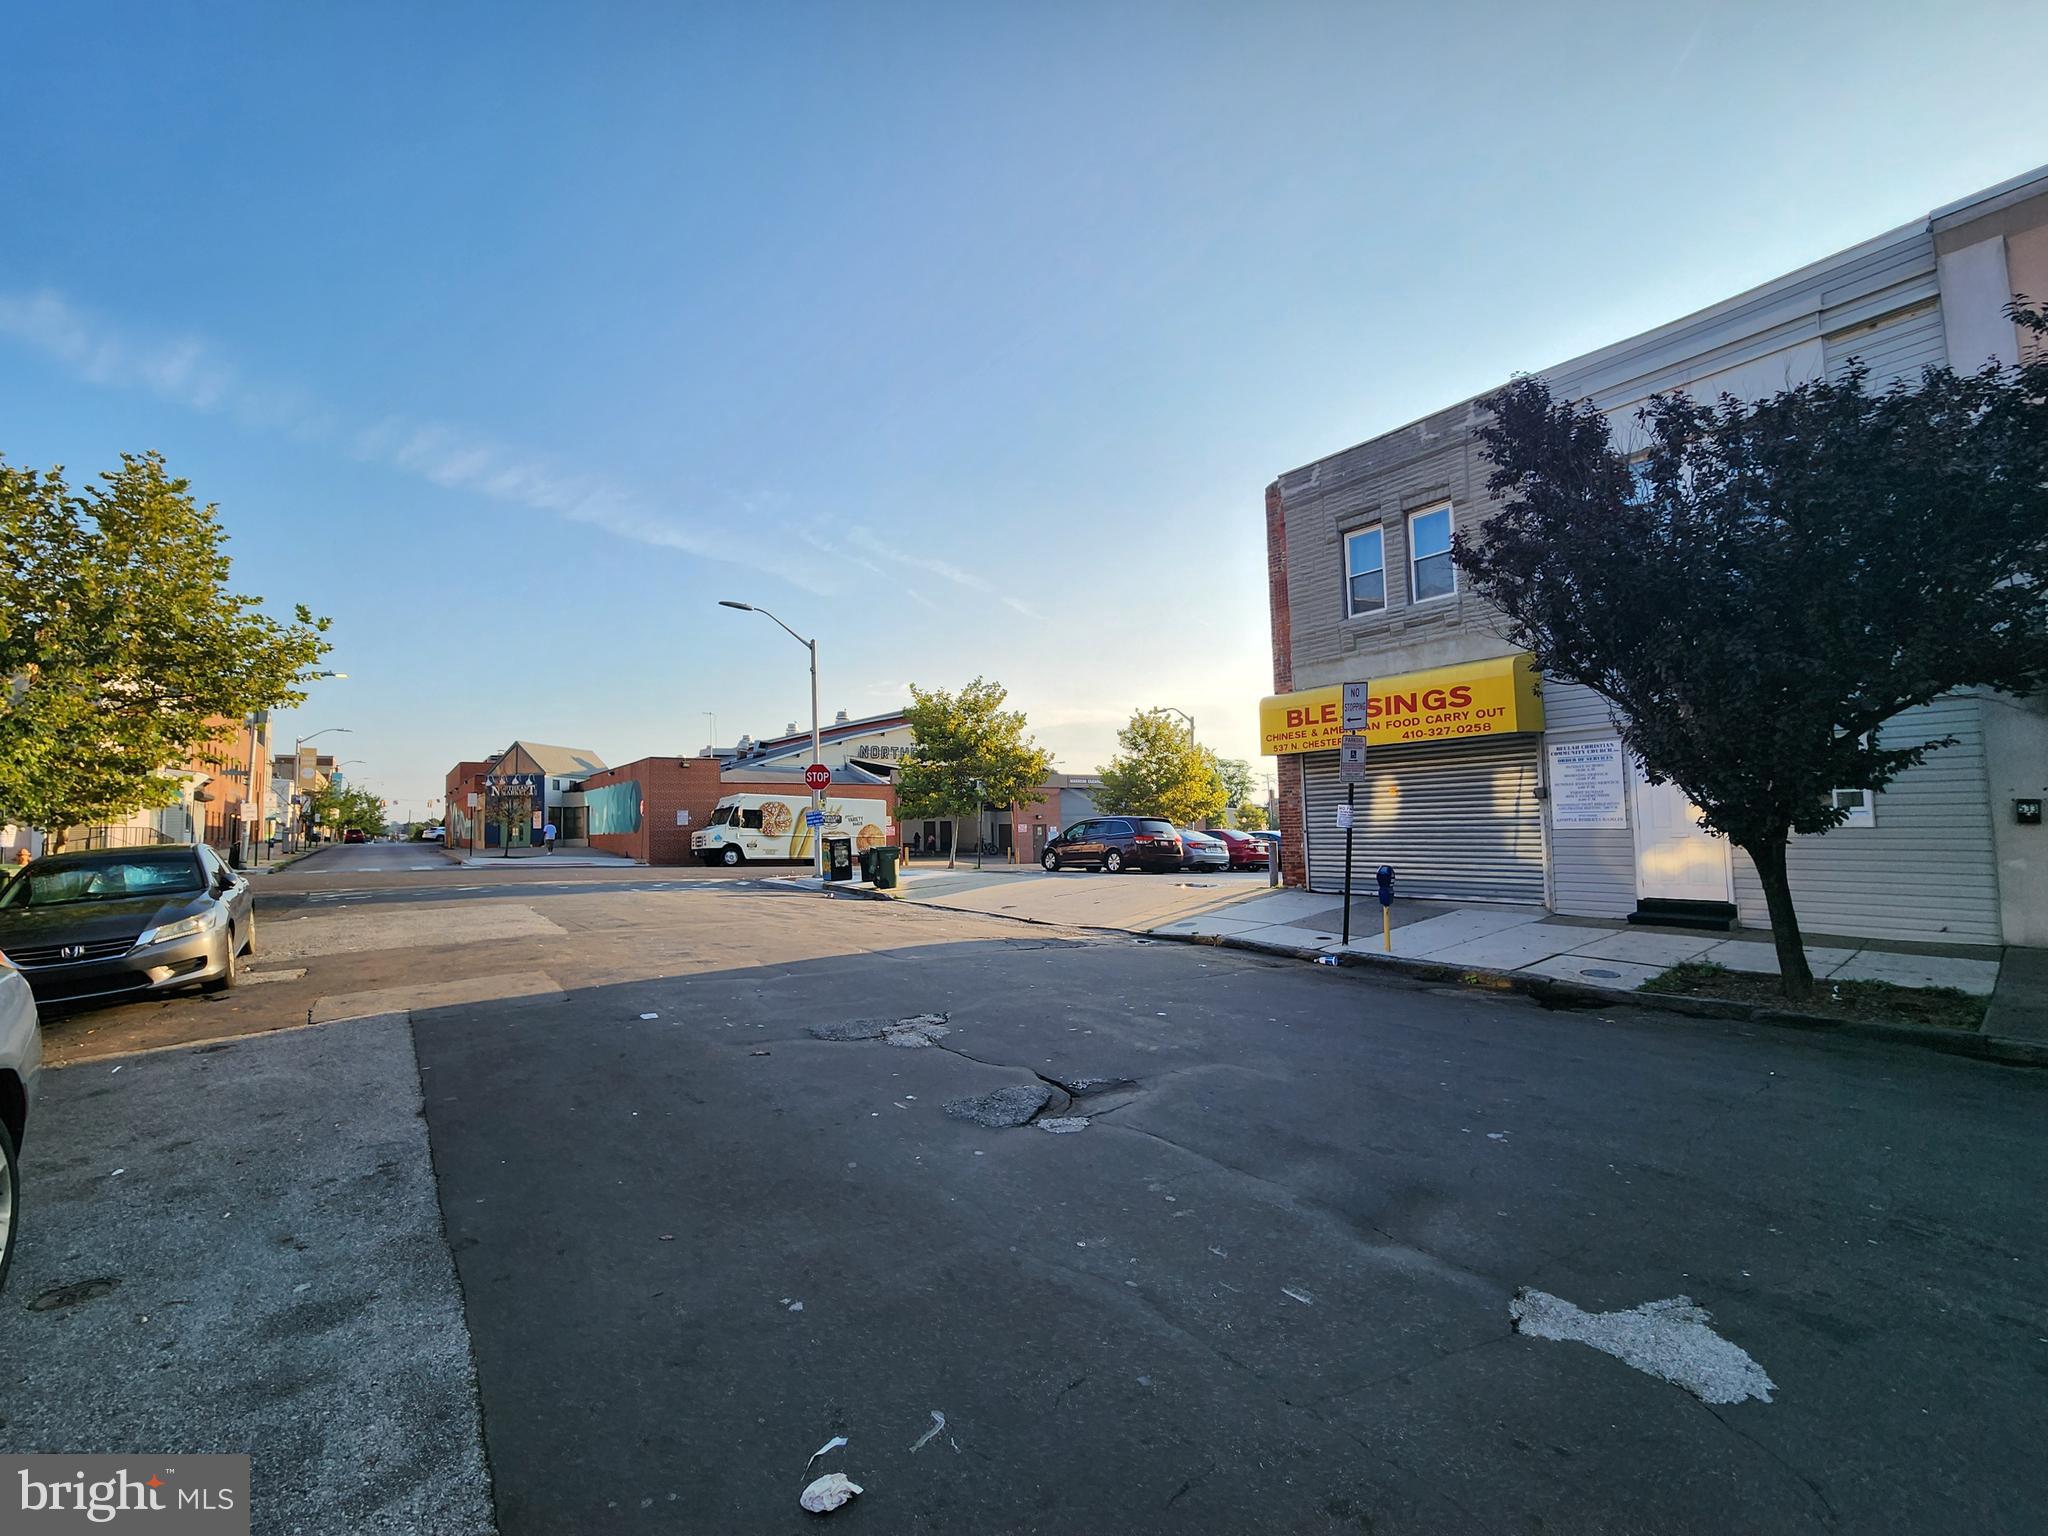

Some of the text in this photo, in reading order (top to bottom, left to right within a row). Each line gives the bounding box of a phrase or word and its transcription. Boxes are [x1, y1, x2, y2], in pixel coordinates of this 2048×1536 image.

[1350, 687, 1360, 697] NO
[1286, 685, 1473, 728] BLESINGS
[1344, 702, 1366, 712] STOPPING
[1266, 707, 1506, 742] CHINESE & AMEAN FOOD CARRY OUT
[1402, 722, 1492, 739] 410-327-0258
[1273, 743, 1288, 752] 537
[1291, 742, 1299, 750] N.
[806, 771, 830, 782] STOP
